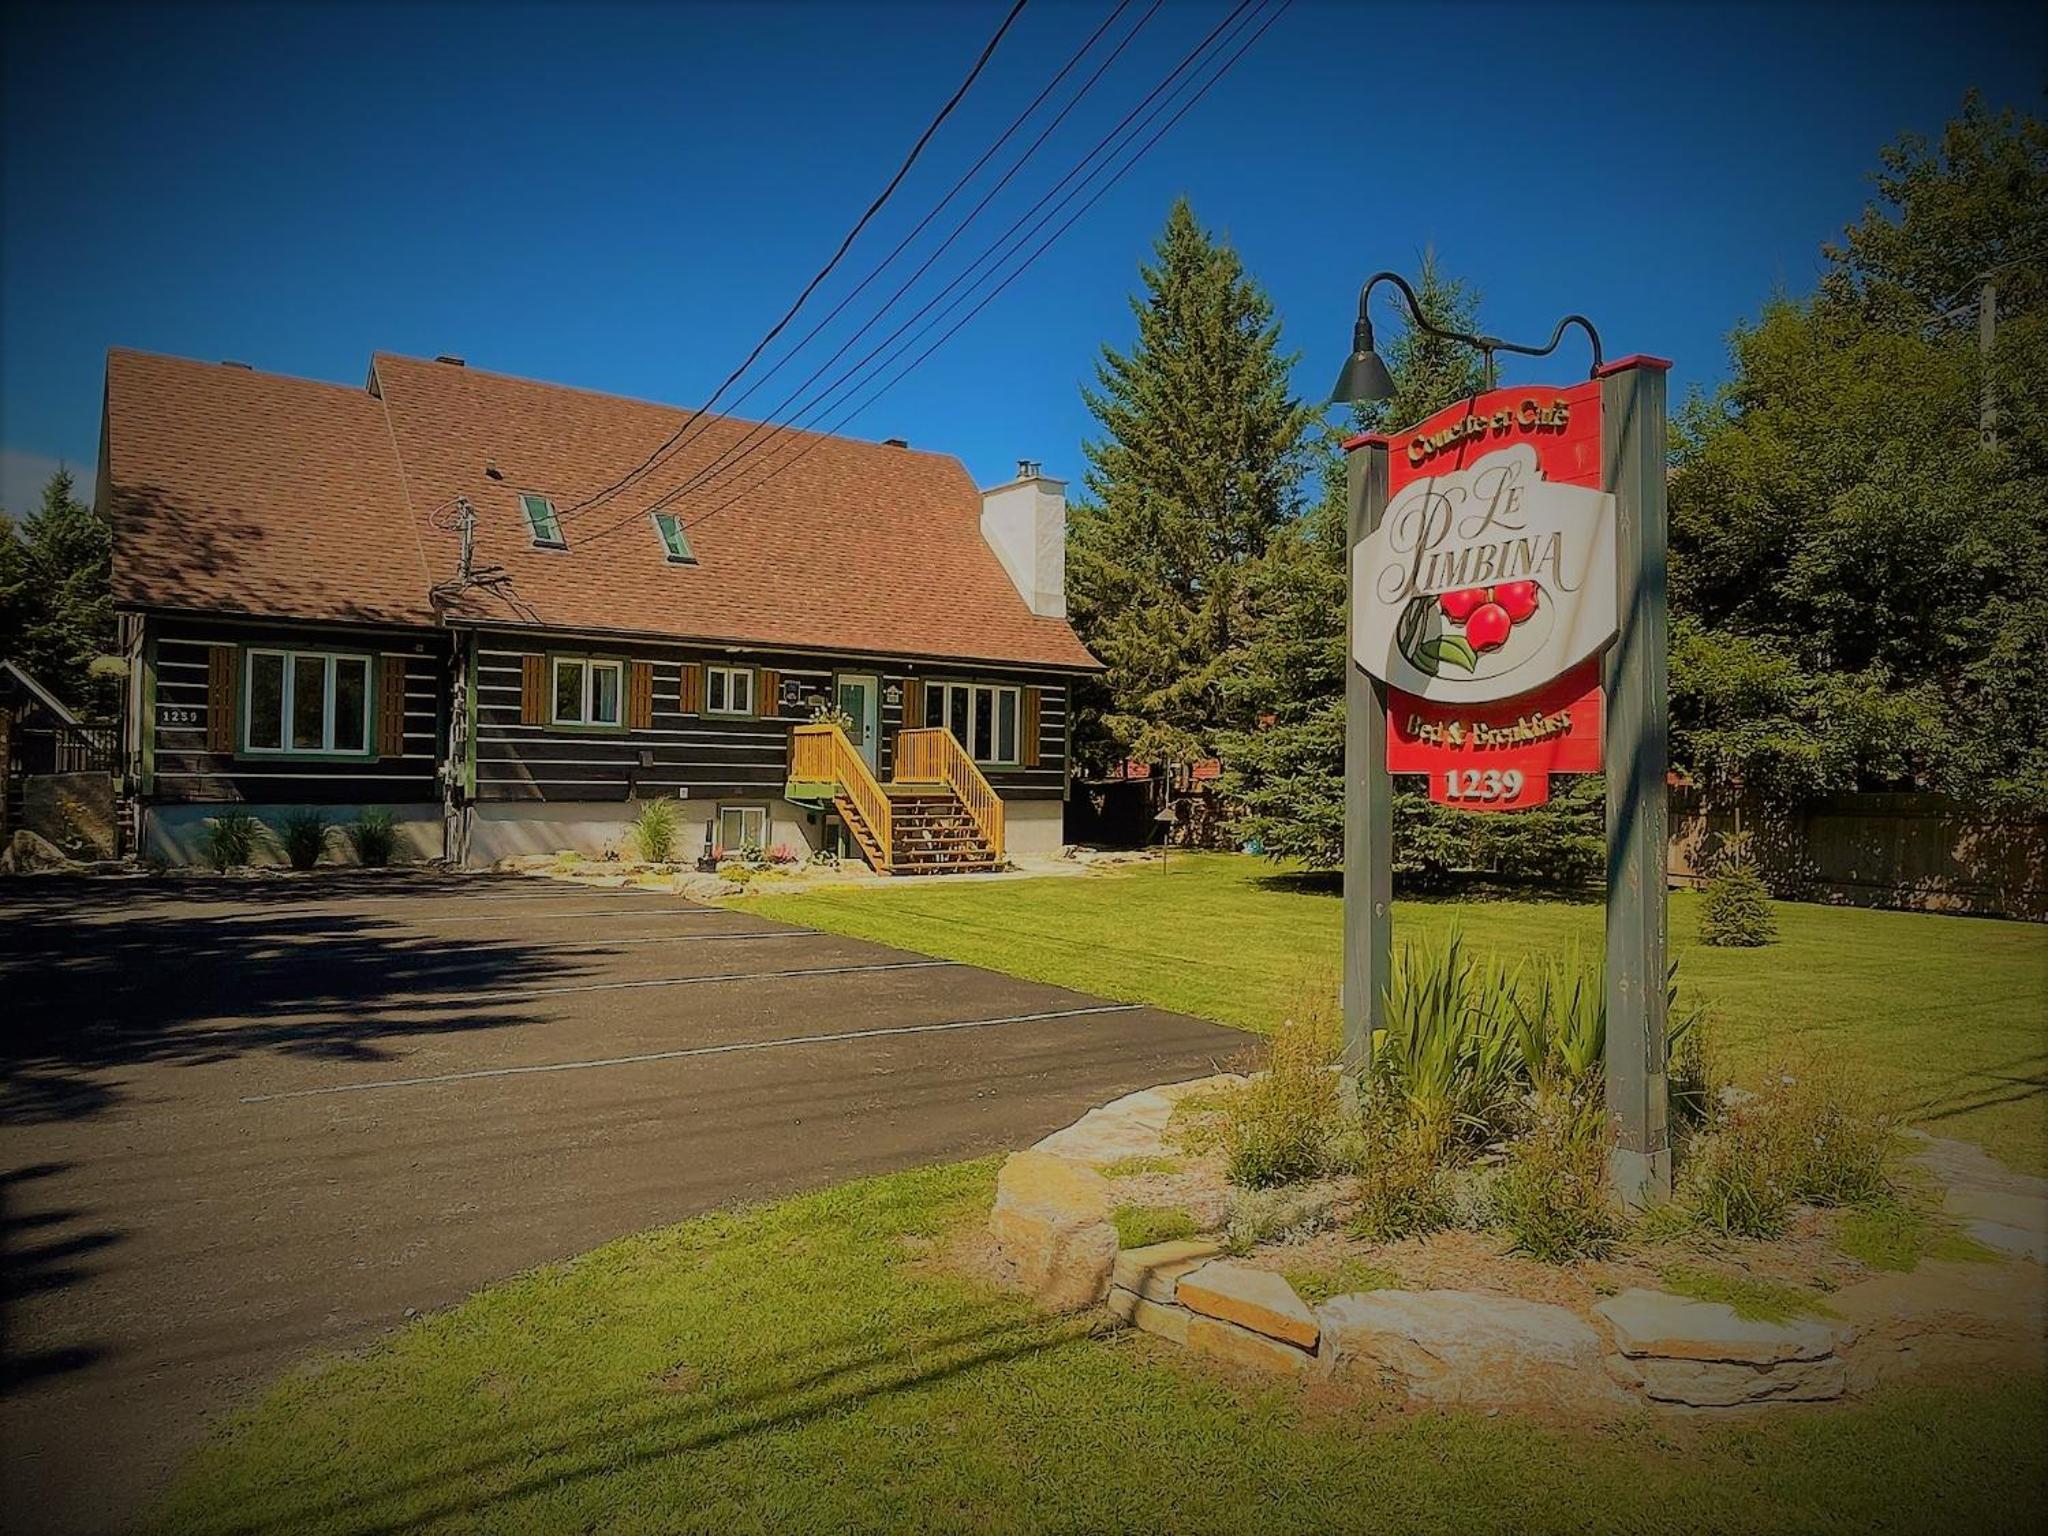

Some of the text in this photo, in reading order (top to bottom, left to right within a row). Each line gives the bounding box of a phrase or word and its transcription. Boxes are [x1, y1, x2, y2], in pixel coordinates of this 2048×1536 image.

[1376, 486, 1579, 605] PIMBINA
[1407, 713, 1444, 742] Bed
[1448, 721, 1467, 746] &
[1446, 769, 1525, 801] 1239
